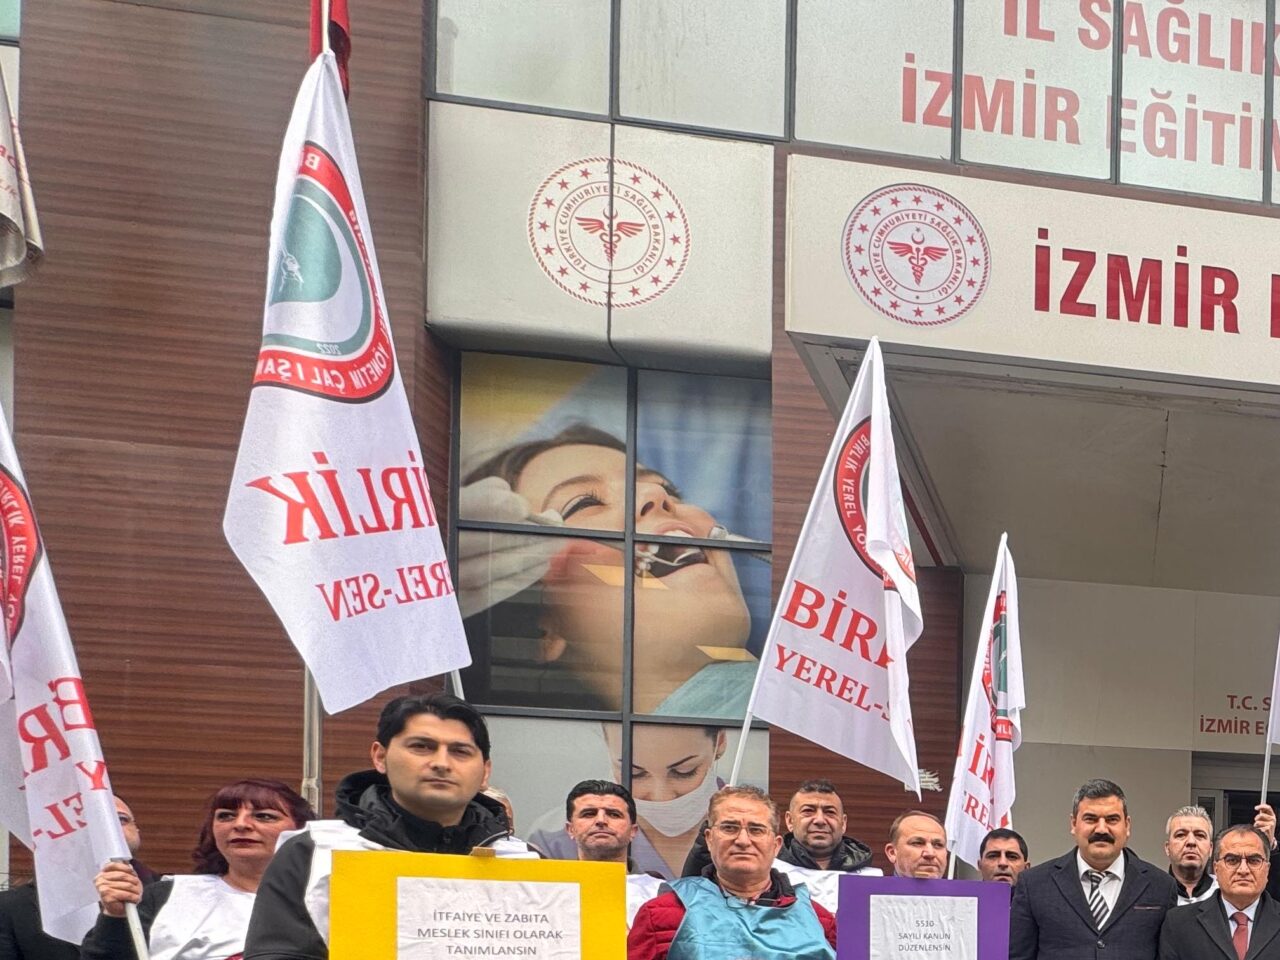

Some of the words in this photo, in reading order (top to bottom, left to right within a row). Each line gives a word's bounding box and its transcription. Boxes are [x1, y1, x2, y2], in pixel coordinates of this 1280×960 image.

[902, 52, 1081, 145] İZMİR
[1034, 226, 1240, 335] İZMİR
[1200, 715, 1250, 735] İZMİR
[433, 909, 481, 923] İTFAİYE
[484, 913, 501, 923] VE
[504, 913, 549, 924] ZABITA
[417, 928, 470, 939] MESLEK
[513, 929, 563, 940] OLARAK
[446, 945, 537, 956] TANIMLANSIN
